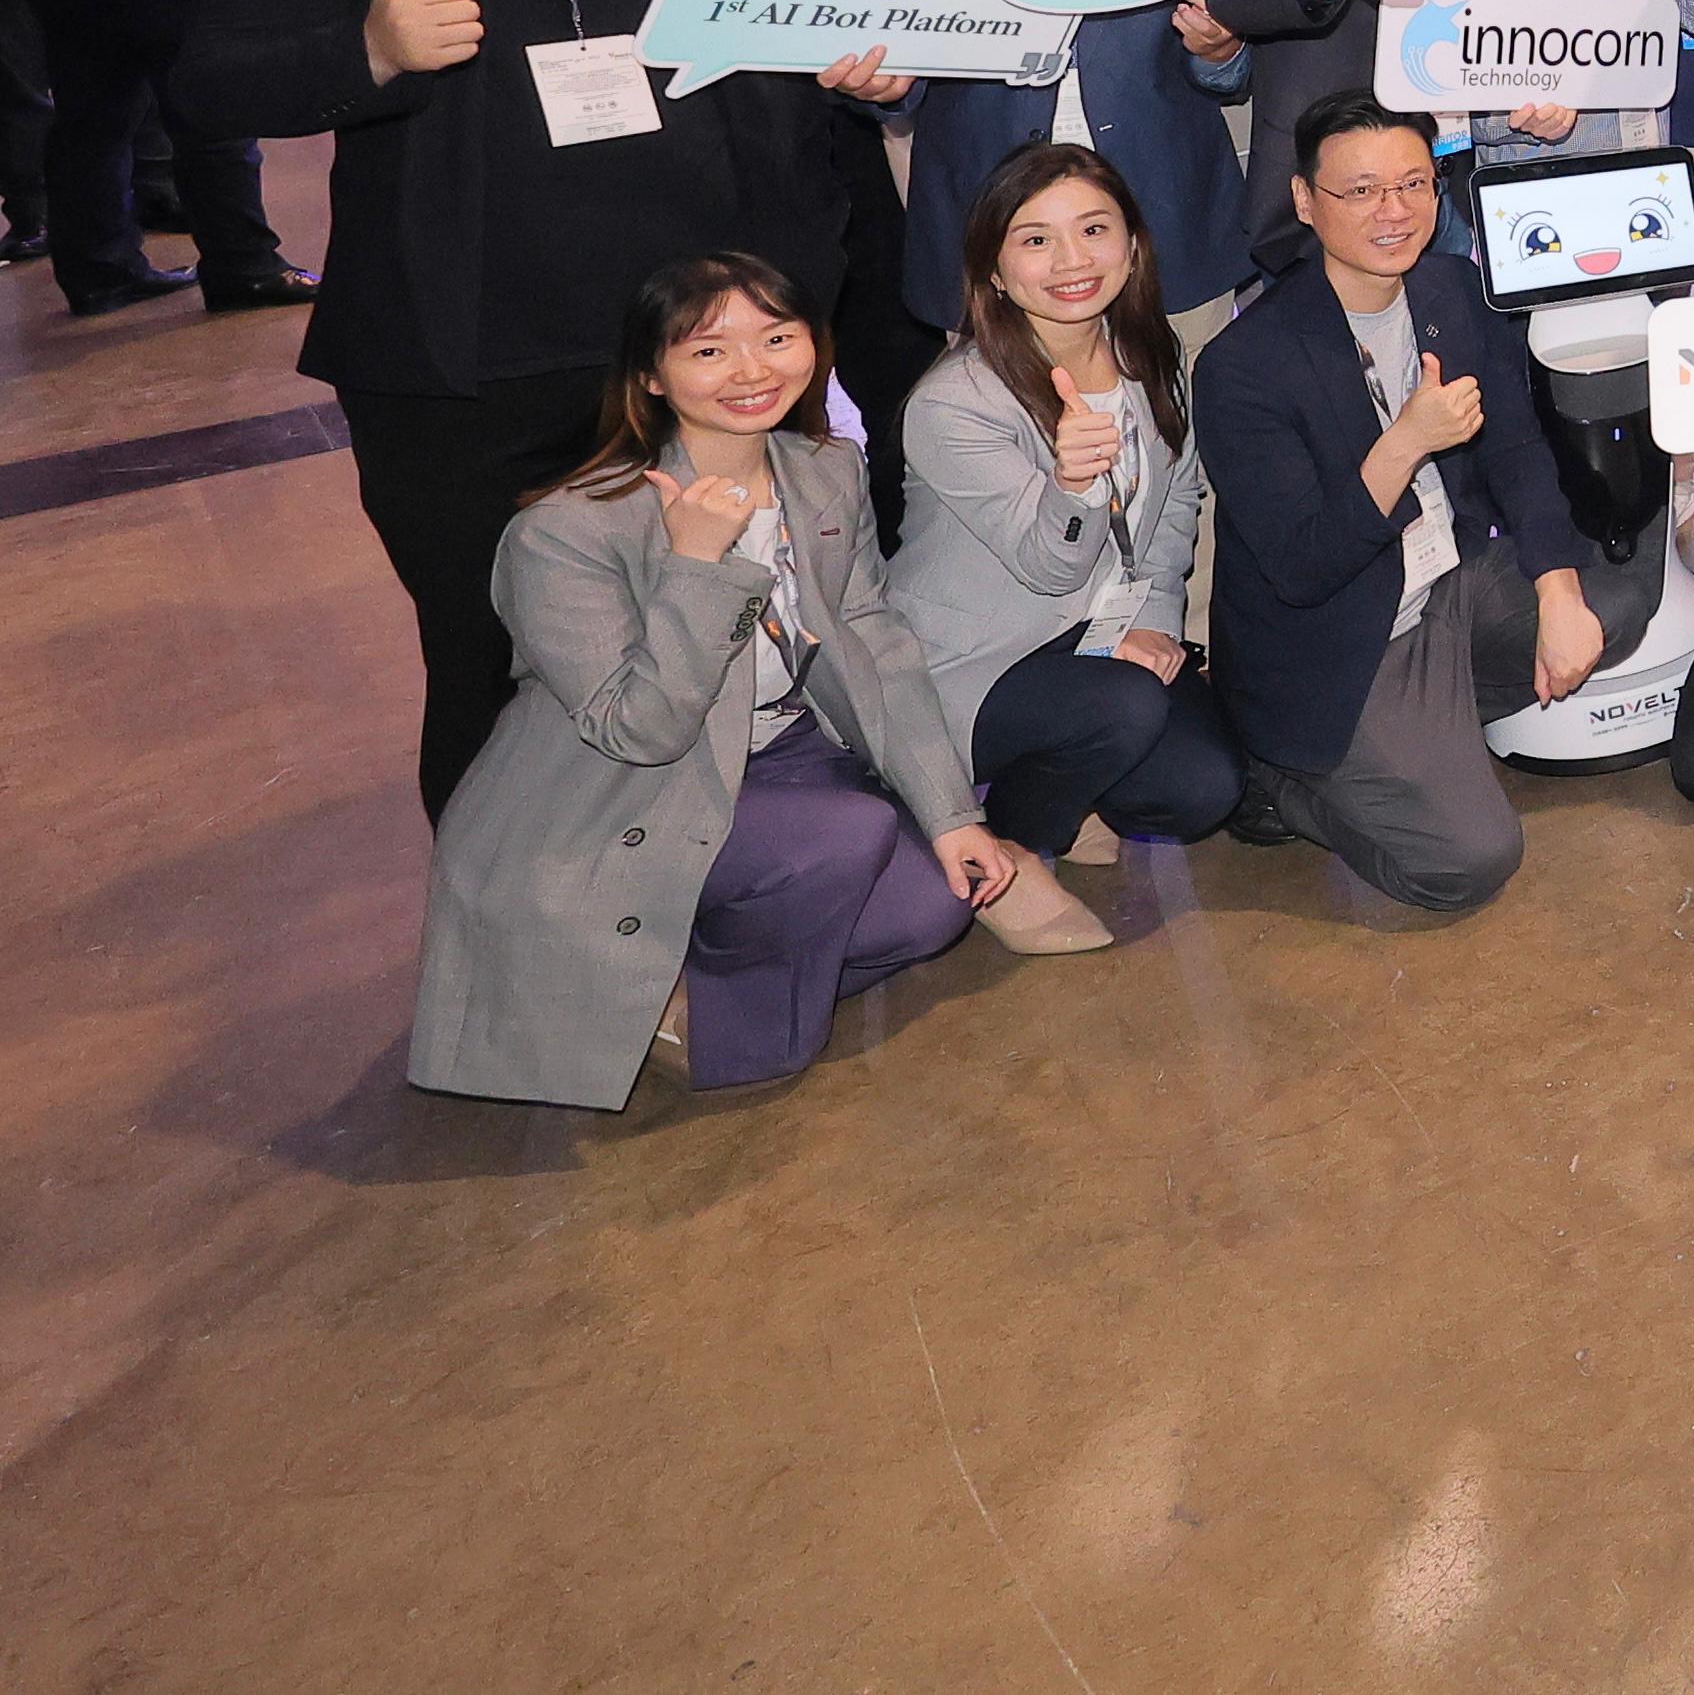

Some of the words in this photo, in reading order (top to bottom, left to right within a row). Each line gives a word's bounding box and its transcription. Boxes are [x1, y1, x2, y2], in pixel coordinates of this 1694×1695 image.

[750, 3, 797, 27] AI
[808, 5, 872, 29] Bot
[882, 8, 1023, 37] Platform
[1461, 7, 1664, 67] innocorn
[1460, 68, 1562, 91] Technology
[1590, 688, 1682, 724] NOVEL
